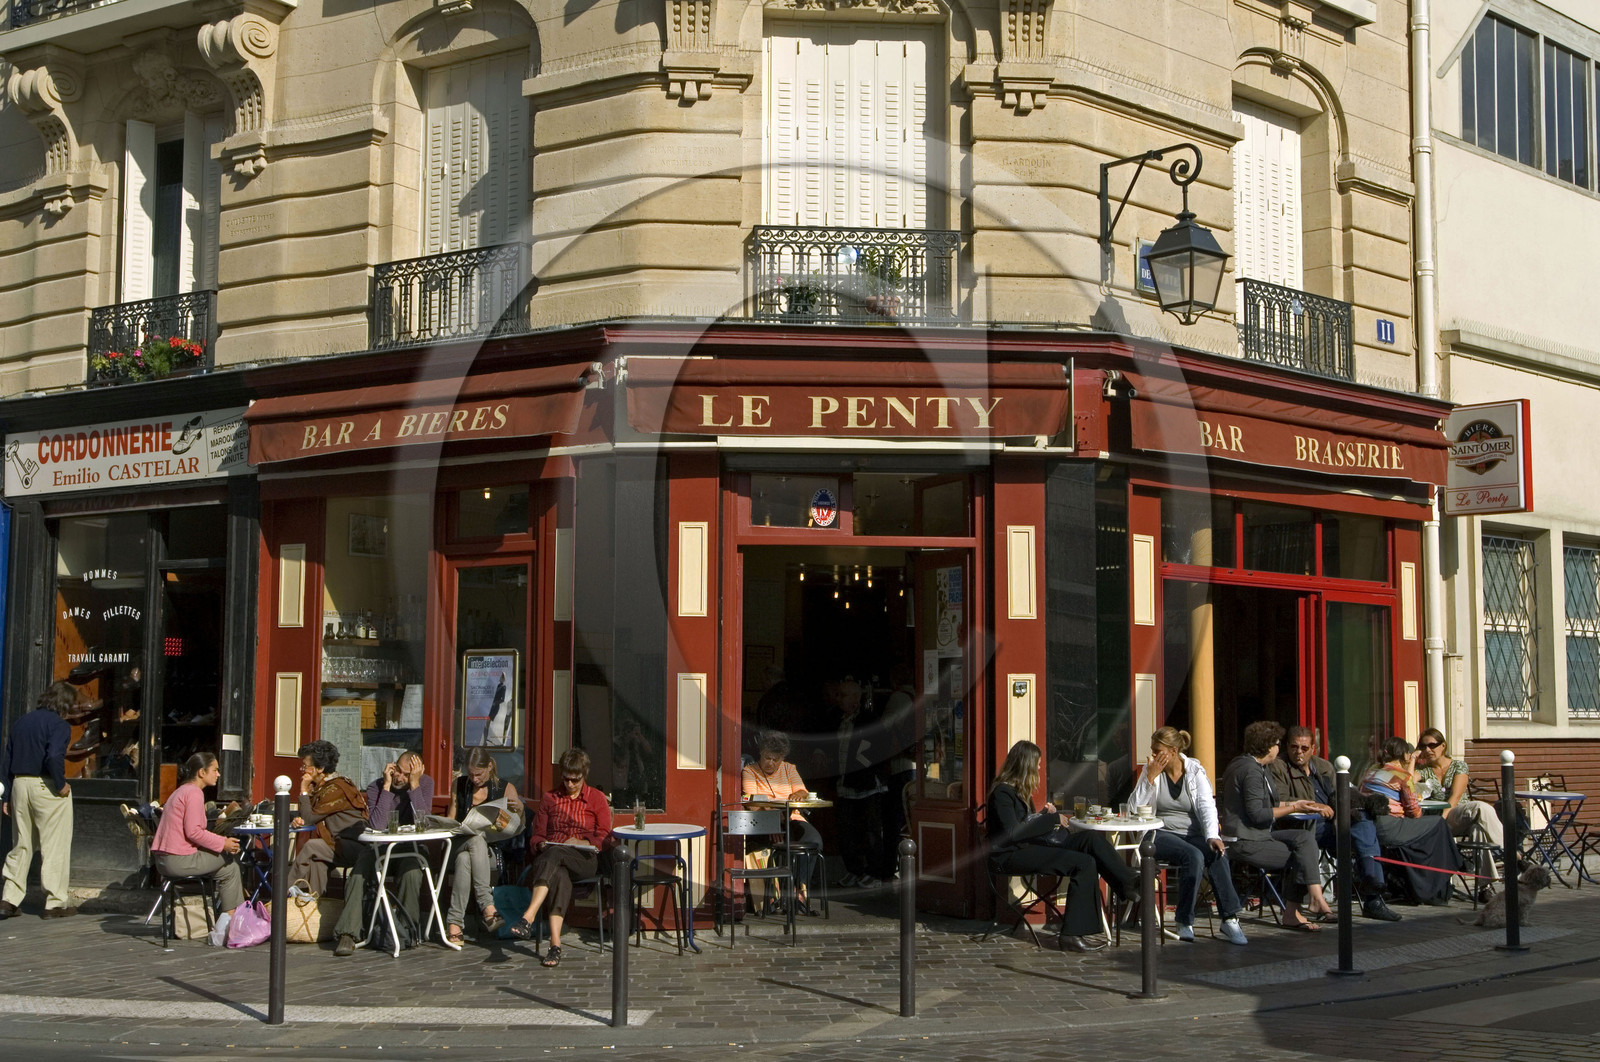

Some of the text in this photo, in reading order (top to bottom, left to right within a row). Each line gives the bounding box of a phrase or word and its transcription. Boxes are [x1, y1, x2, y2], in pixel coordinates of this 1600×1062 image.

[1380, 321, 1392, 342] 11
[698, 394, 1004, 429] LE PENTY
[300, 404, 510, 451] BAR A BIERES
[38, 421, 173, 465] CORDONNERIE
[210, 445, 232, 460] TALONS
[1197, 420, 1405, 470] BAR BRASSERIE
[221, 451, 245, 466] MINUTE
[52, 457, 200, 487] Emilio CASTELAR
[1456, 490, 1509, 508] Le Penty
[83, 568, 118, 582] HOMMES
[62, 605, 141, 621] DAMES FILLETTES
[68, 652, 129, 663] TRAVAIL GARANTI
